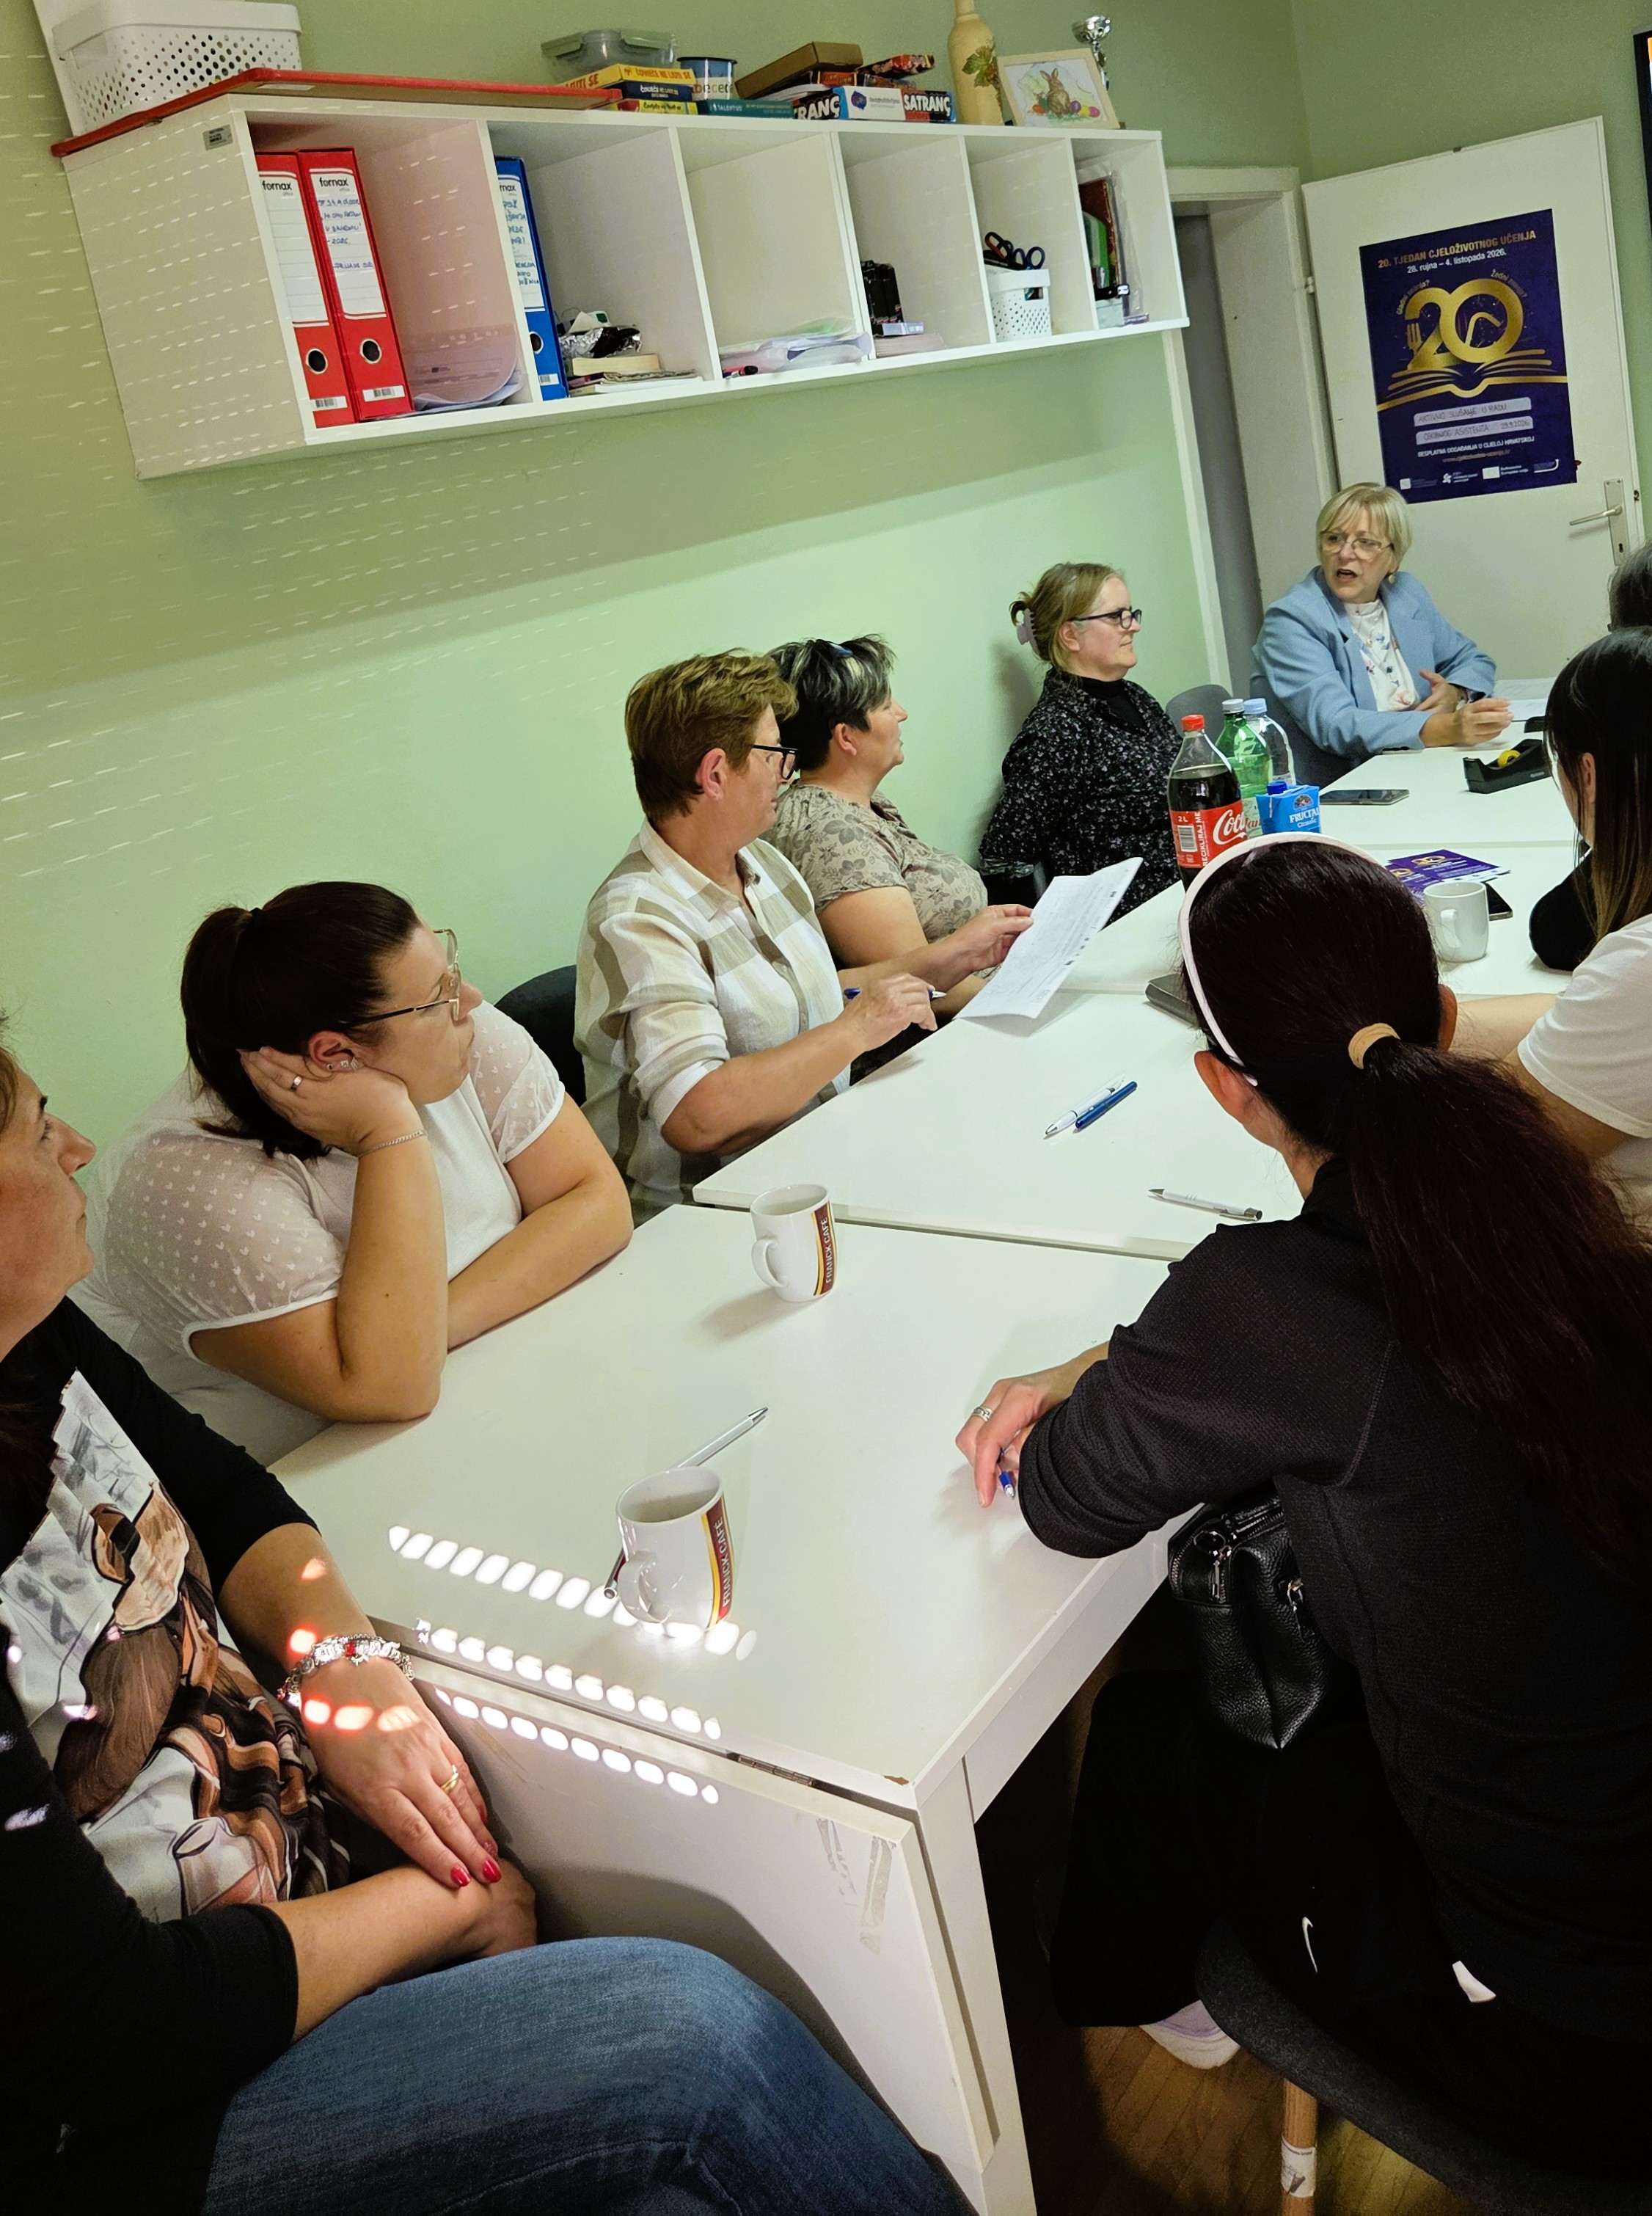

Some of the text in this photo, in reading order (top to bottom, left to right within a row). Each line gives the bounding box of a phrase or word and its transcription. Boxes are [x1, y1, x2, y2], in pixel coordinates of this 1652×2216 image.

[588, 73, 599, 87] SE
[794, 95, 841, 120] RANÇ
[903, 92, 951, 117] SATRANÇ
[262, 180, 293, 191] fornax
[319, 177, 349, 187] fornax
[1378, 230, 1537, 269] 20. TJEDAN CJELOŽIVOTNOG UČENJA
[1419, 261, 1438, 273] rujna
[1445, 258, 1453, 266] 4.
[1453, 252, 1485, 265] listopada
[1488, 404, 1507, 412] RADU
[1194, 811, 1202, 823] ME
[1289, 807, 1320, 823] FRUCTAL
[825, 1244, 833, 1283] FRANCK
[721, 1553, 731, 1607] FRANCK
